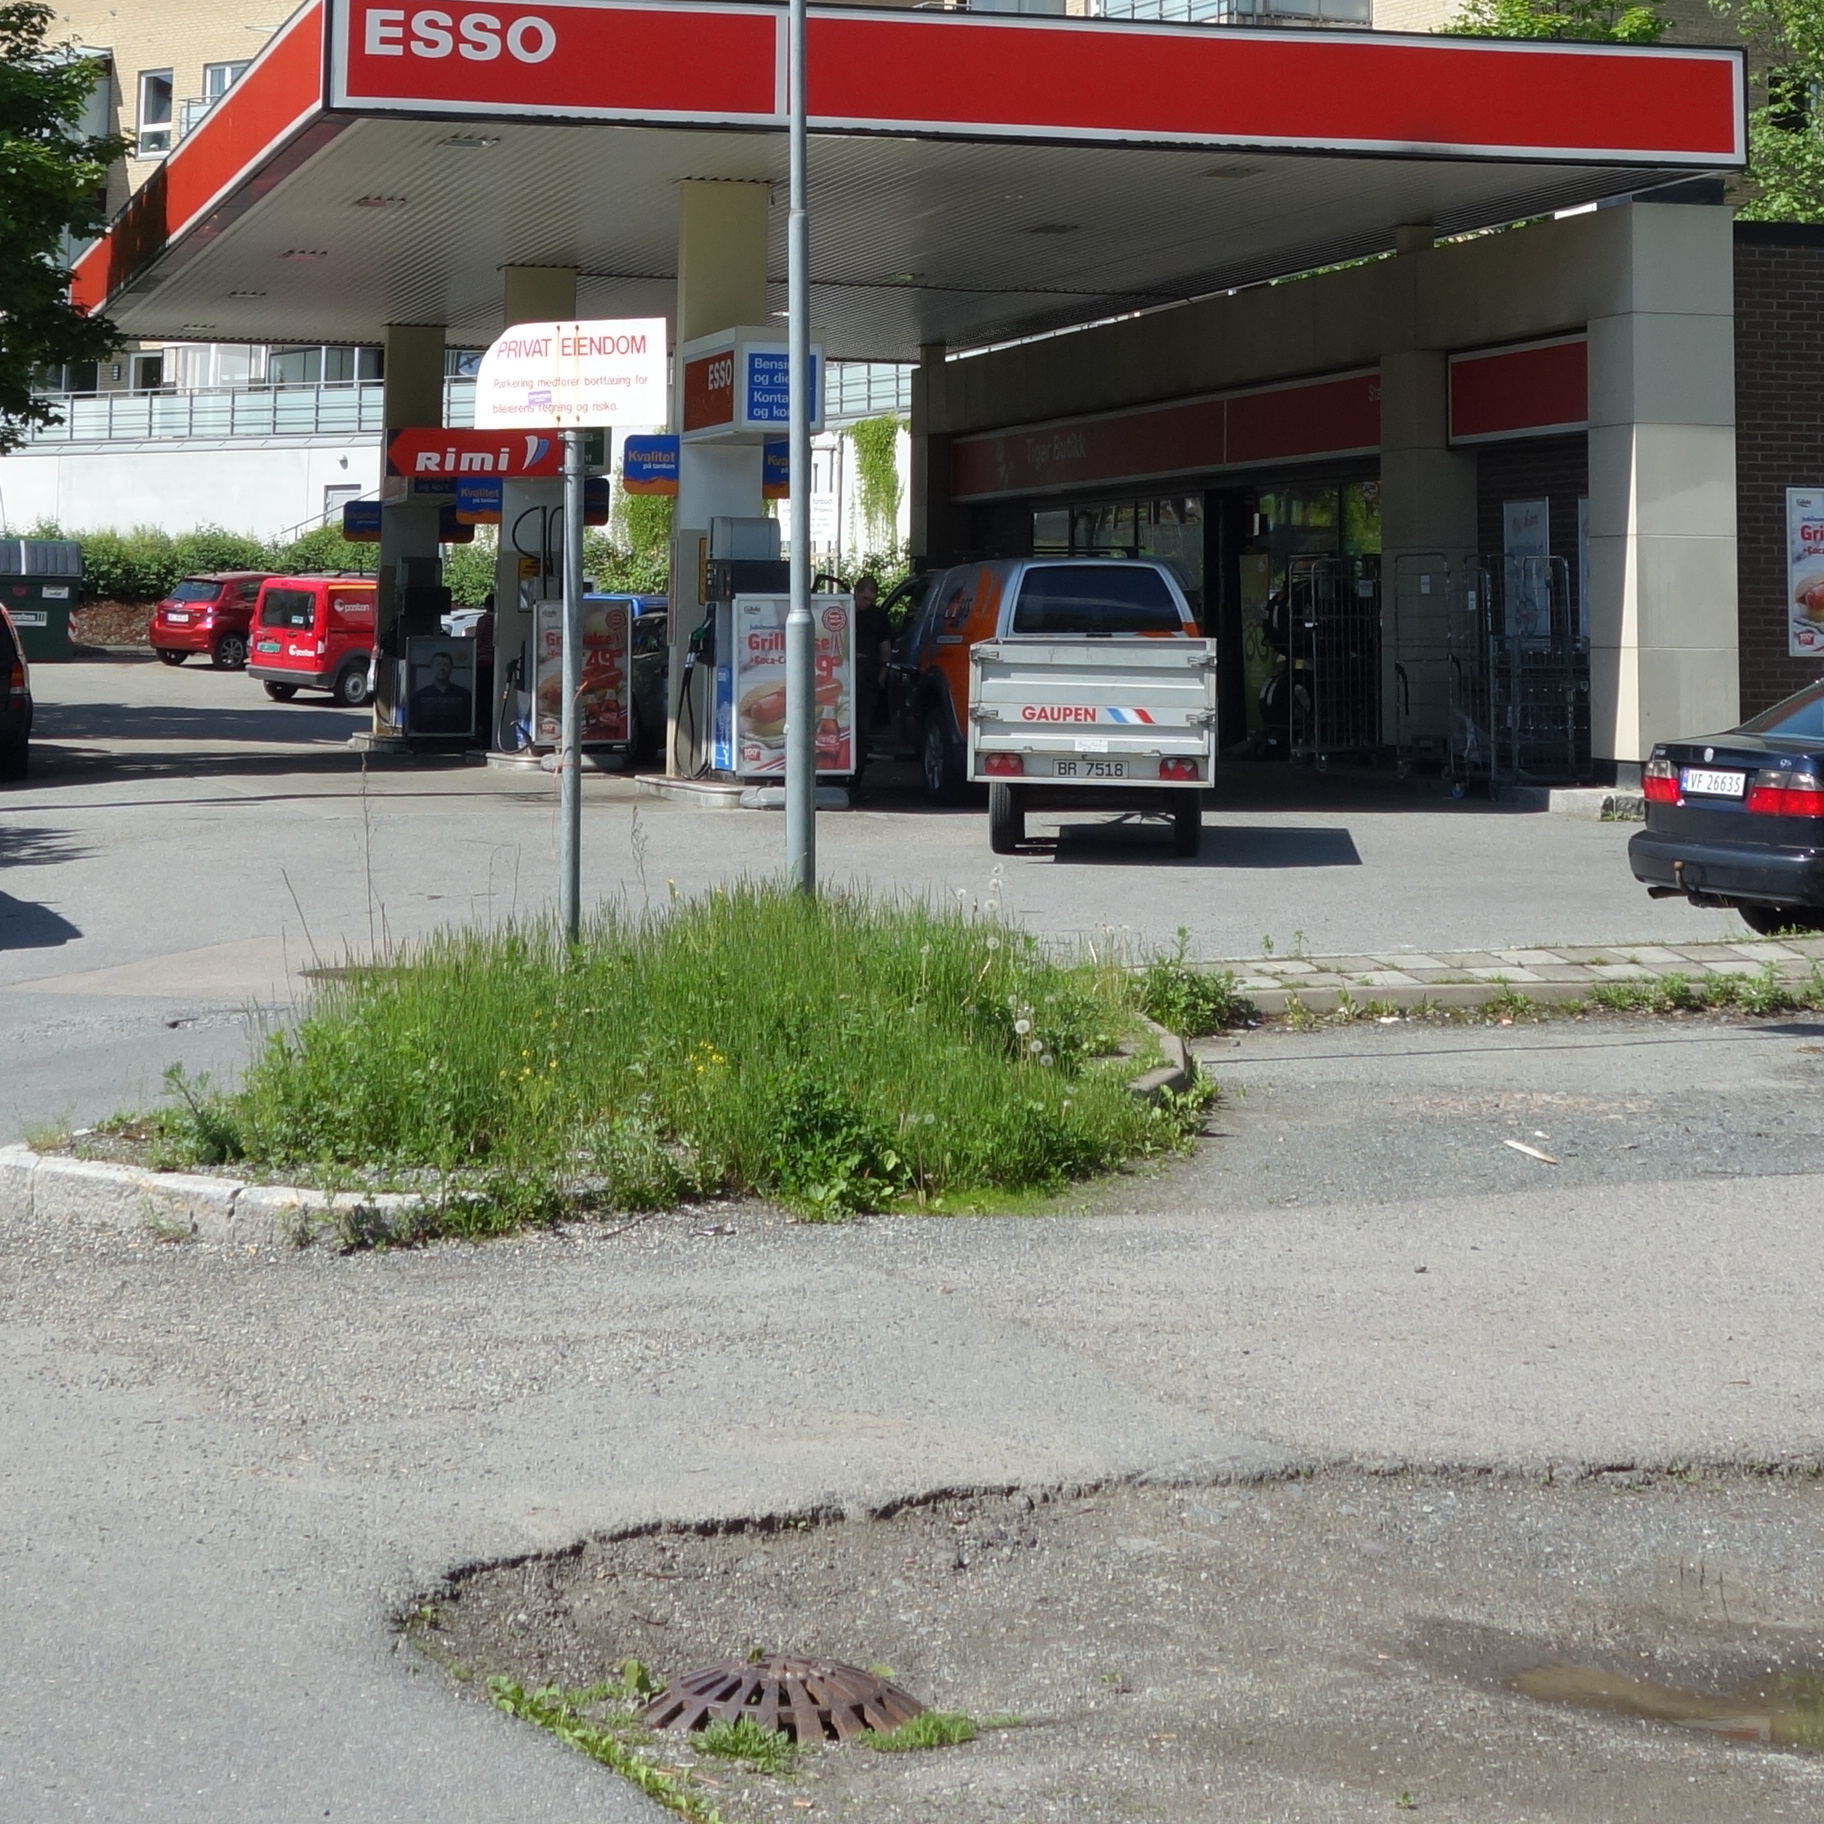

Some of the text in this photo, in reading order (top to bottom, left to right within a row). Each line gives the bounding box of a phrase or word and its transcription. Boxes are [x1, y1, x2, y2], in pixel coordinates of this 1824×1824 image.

[364, 8, 557, 64] ESSO
[496, 335, 647, 359] PRIVAT EIENDOM
[754, 357, 789, 370] Bensi
[493, 378, 534, 390] Parkering
[635, 374, 649, 385] for
[708, 359, 733, 391] ESSO
[753, 375, 769, 385] og
[538, 403, 572, 415] regning
[576, 404, 588, 414] og
[753, 408, 768, 418] og
[629, 450, 676, 463] Kvalitet
[1026, 432, 1086, 470] Tiger Butikk
[643, 462, 651, 470] på
[460, 487, 499, 498] Kvalitet
[1021, 705, 1097, 723] GAUPEN
[1058, 761, 1124, 777] BR 7518
[1691, 773, 1741, 793] VF 26635
